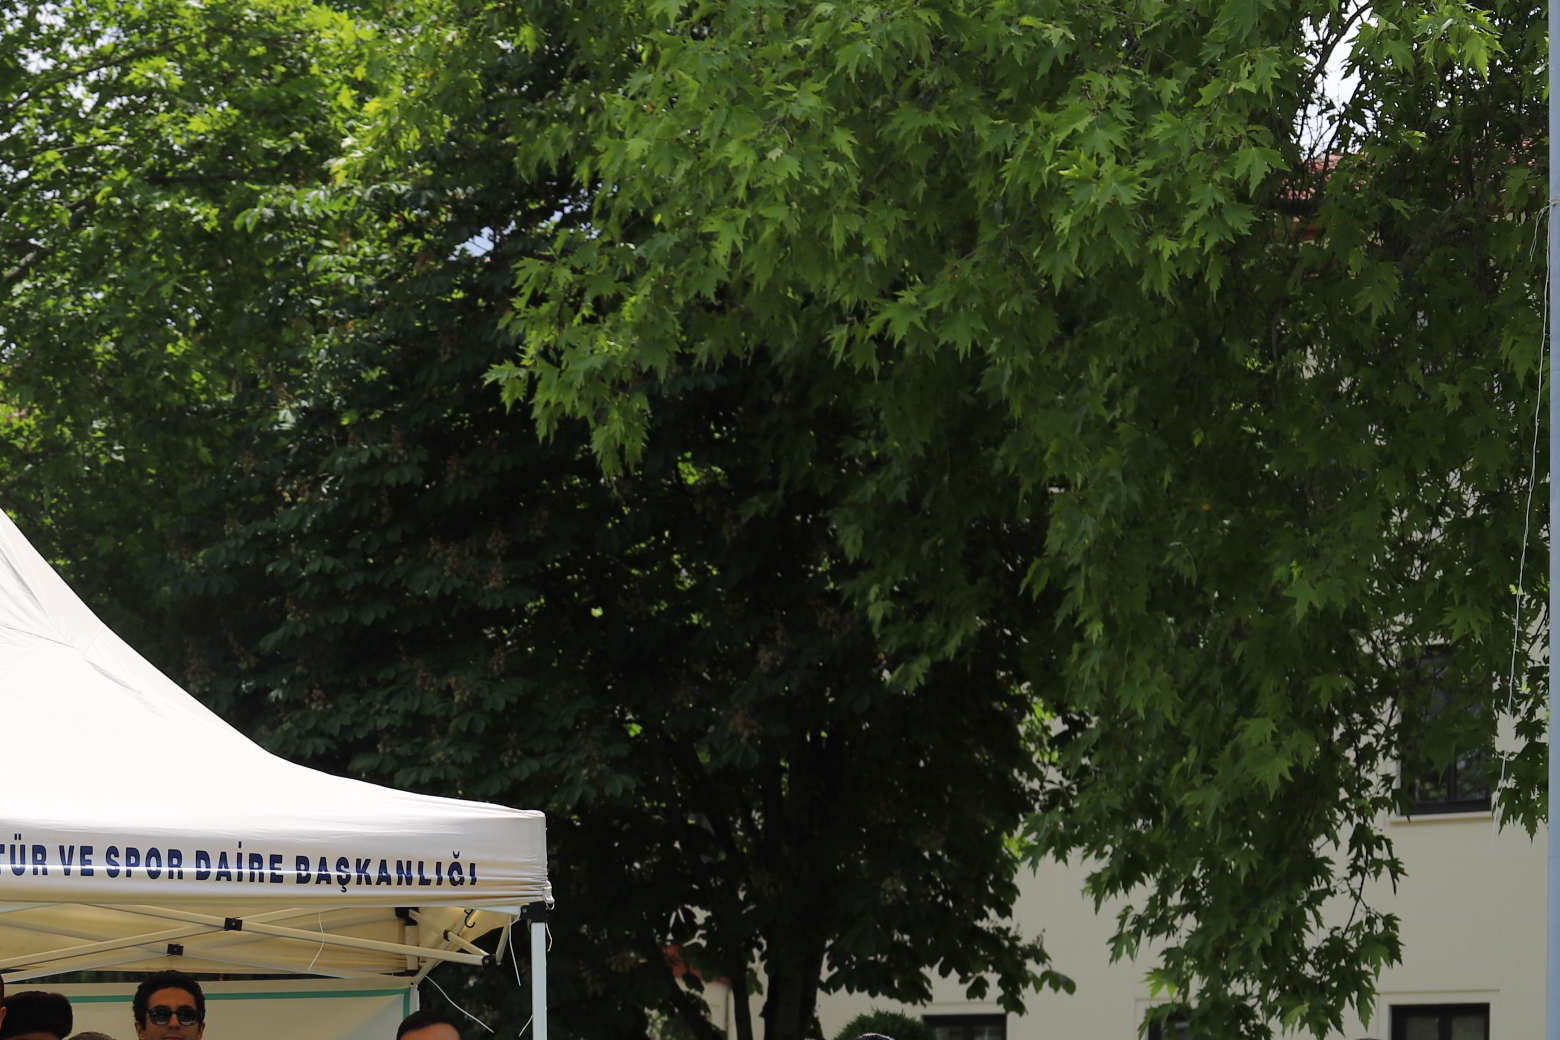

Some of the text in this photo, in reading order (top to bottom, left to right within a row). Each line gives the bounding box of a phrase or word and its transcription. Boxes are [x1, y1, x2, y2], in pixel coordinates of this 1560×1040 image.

[58, 844, 95, 877] VE
[105, 845, 183, 880] SPOR
[195, 841, 284, 884] DAİRE
[295, 850, 478, 893] BAŞKANLIĞI
